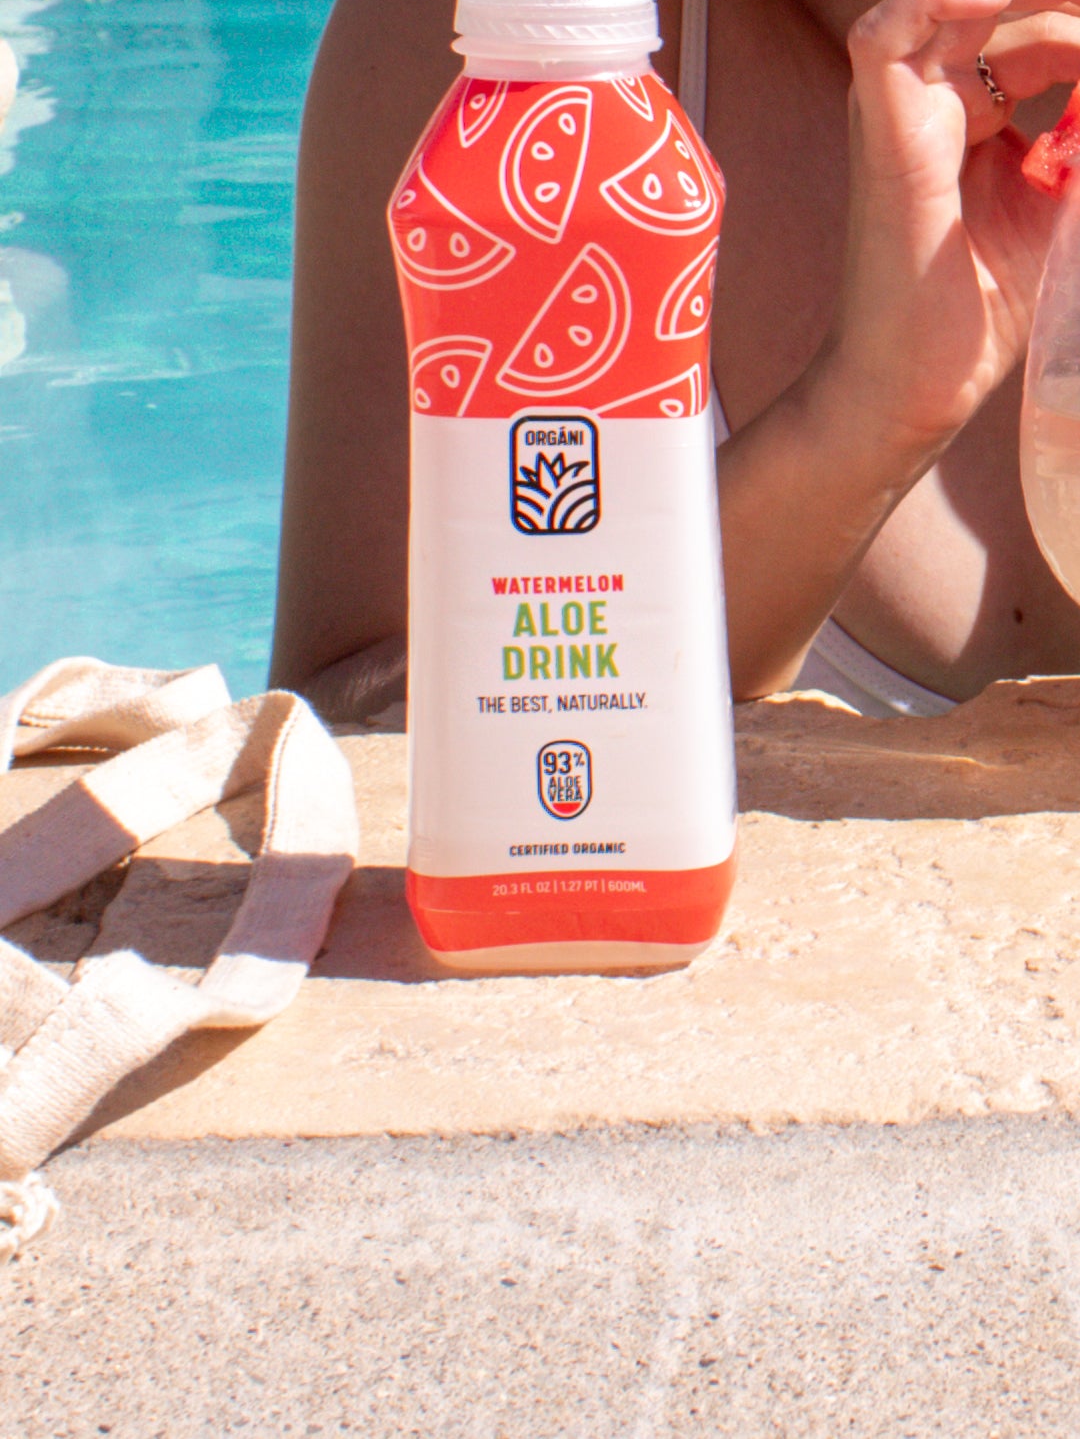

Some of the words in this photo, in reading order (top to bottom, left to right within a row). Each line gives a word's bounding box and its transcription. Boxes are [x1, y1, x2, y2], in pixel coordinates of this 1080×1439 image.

[525, 426, 584, 445] ORGÁNI
[491, 574, 624, 595] WATERMELON
[512, 600, 608, 638] ALOE
[502, 643, 620, 681] DRINK
[477, 696, 506, 713] THE
[511, 696, 552, 714] BEST,
[557, 692, 648, 711] NATURALLY.
[543, 751, 585, 775] 93%
[548, 775, 582, 789] ALOE
[548, 788, 583, 802] VERA
[509, 843, 569, 857] CERTIFIED
[572, 842, 626, 854] ORGANIC
[492, 883, 518, 896] 20.3
[520, 882, 533, 894] FL
[536, 881, 551, 893] OZ
[560, 880, 582, 892] 1.27
[585, 880, 598, 891] PT
[608, 881, 647, 893] 600ML
